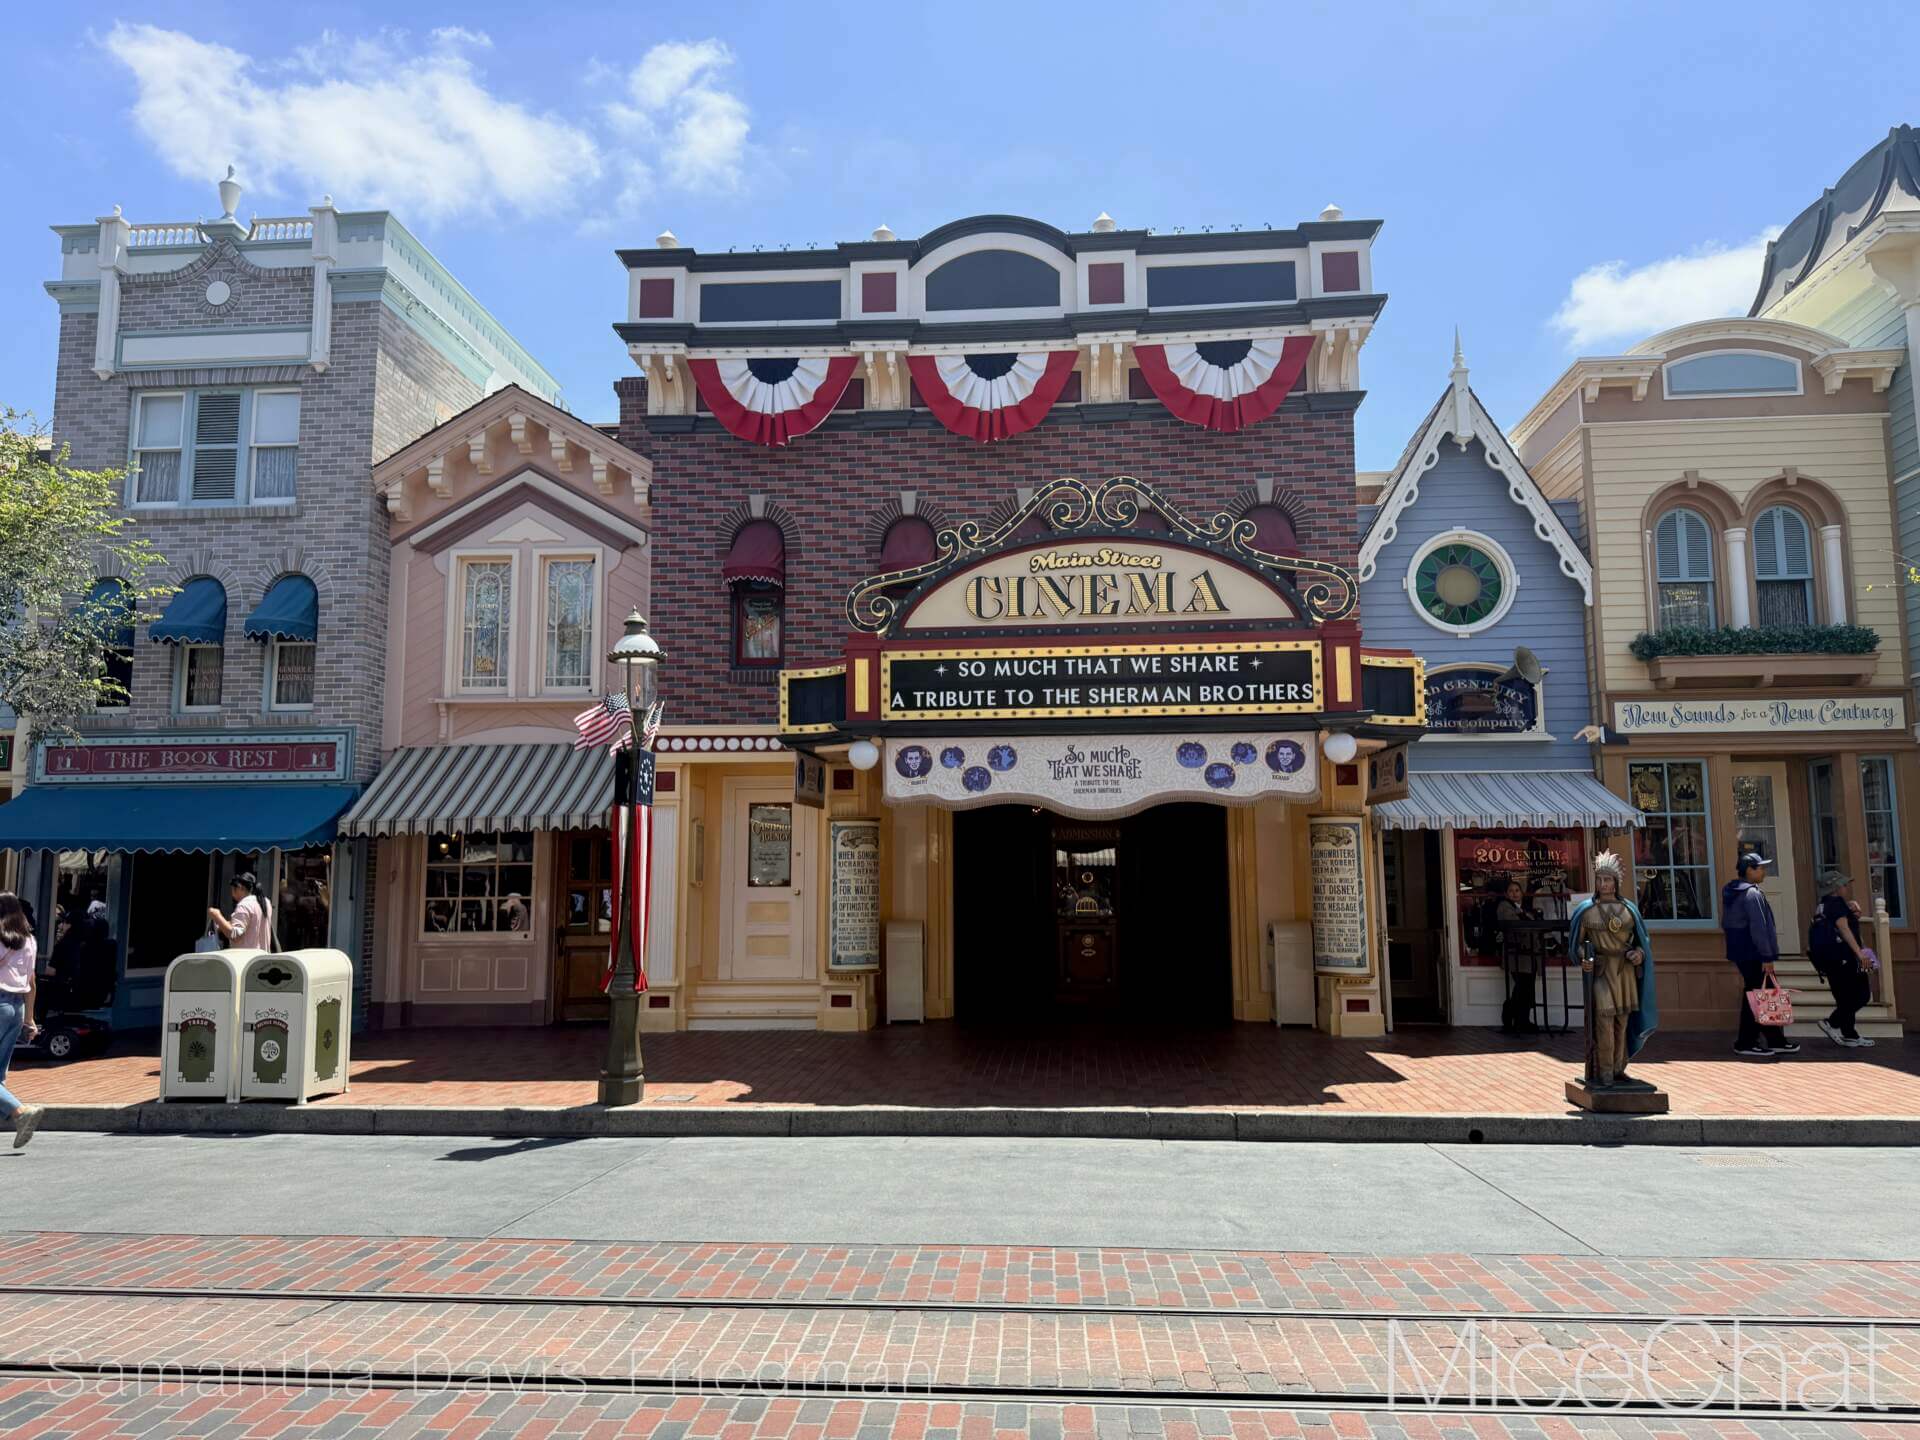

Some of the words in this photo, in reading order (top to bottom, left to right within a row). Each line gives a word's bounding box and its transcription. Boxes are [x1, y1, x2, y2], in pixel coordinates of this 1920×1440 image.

[1031, 552, 1092, 573] Main
[1092, 548, 1162, 570] Street
[966, 569, 1231, 620] CINEMA
[958, 661, 986, 677] SO
[994, 659, 1057, 676] MUCH
[1064, 658, 1121, 675] THAT
[1130, 657, 1161, 674] WE
[1170, 656, 1239, 672] SHARE
[891, 692, 905, 708] A
[913, 689, 997, 707] TRIBUTE
[1005, 688, 1034, 705] TO
[1043, 687, 1080, 704] THE
[1088, 685, 1191, 704] SHERMAN
[1199, 684, 1313, 702] BROTHERS
[1458, 719, 1527, 730] Company
[1622, 703, 1669, 728] New
[1669, 703, 1736, 728] Sounds
[1741, 708, 1756, 720] for
[1769, 701, 1816, 729] New
[1818, 700, 1897, 727] Century
[105, 751, 150, 768] THE
[160, 750, 217, 767] BOOK
[228, 750, 278, 768] REST
[1091, 745, 1131, 765] MUCH
[1047, 760, 1079, 780] THAT
[1082, 766, 1101, 777] WE
[1103, 758, 1142, 779] SHARE
